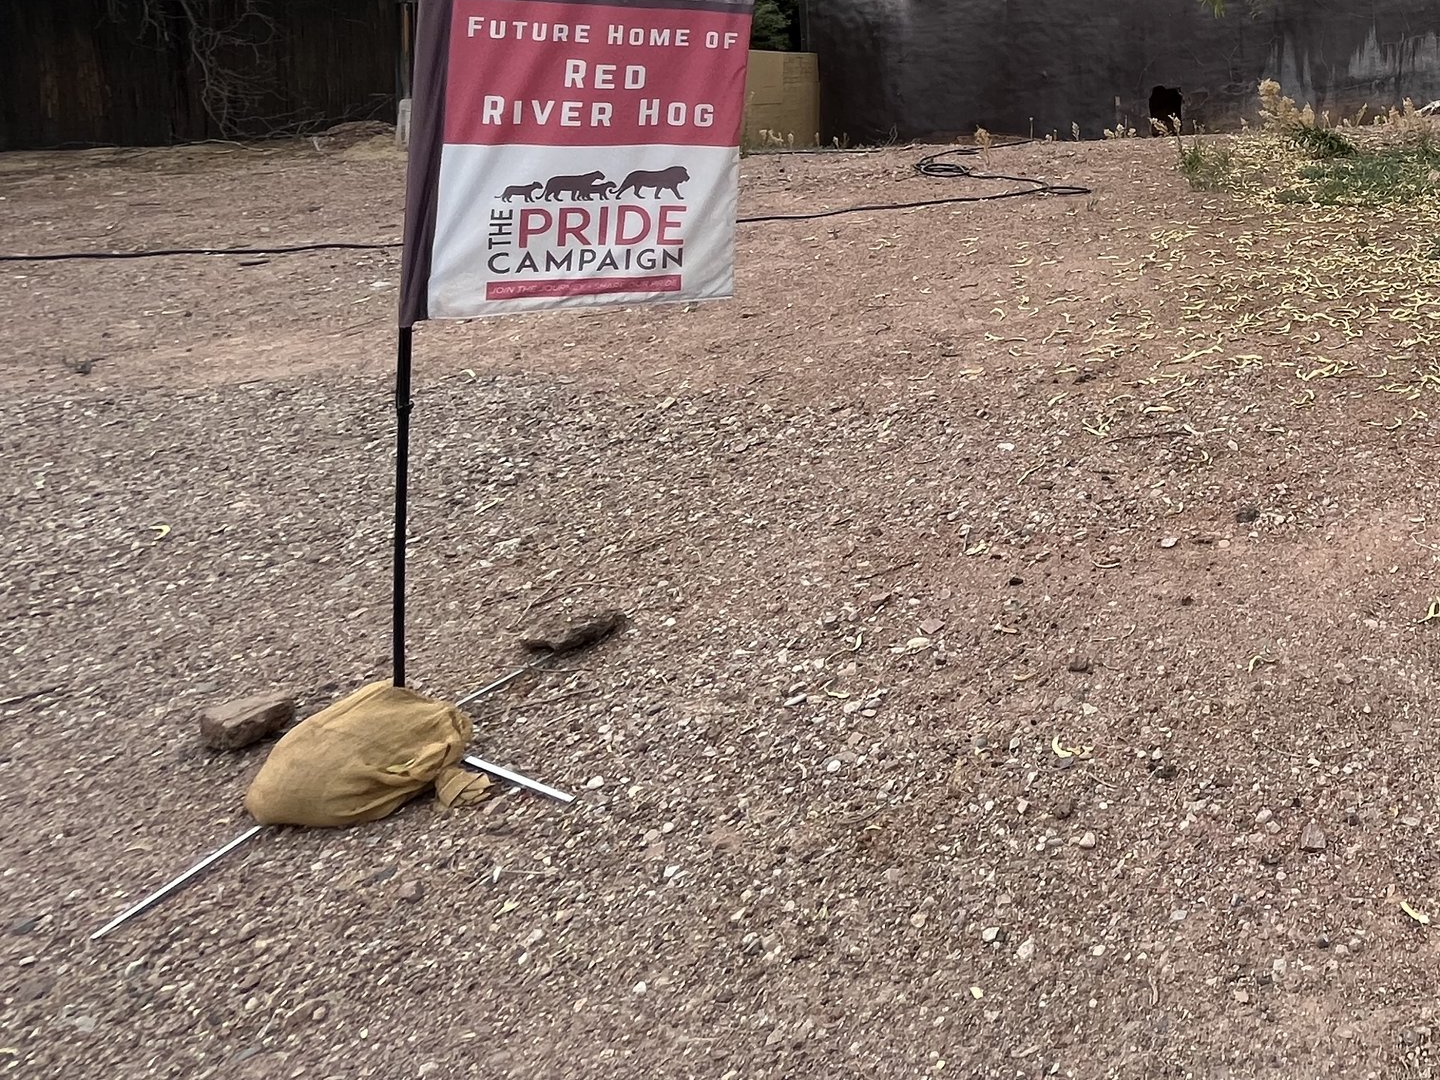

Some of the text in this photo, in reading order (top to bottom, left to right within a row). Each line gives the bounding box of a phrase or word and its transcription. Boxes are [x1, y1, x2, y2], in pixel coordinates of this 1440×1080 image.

[467, 16, 739, 49] FUTURE HOME OF
[564, 59, 647, 90] RED
[482, 95, 715, 127] RIVER HOG
[488, 208, 513, 250] THE
[518, 204, 687, 249] PRIDE
[487, 248, 684, 275] CAMPAIGN
[489, 285, 515, 295] JOIN
[517, 284, 538, 294] THE
